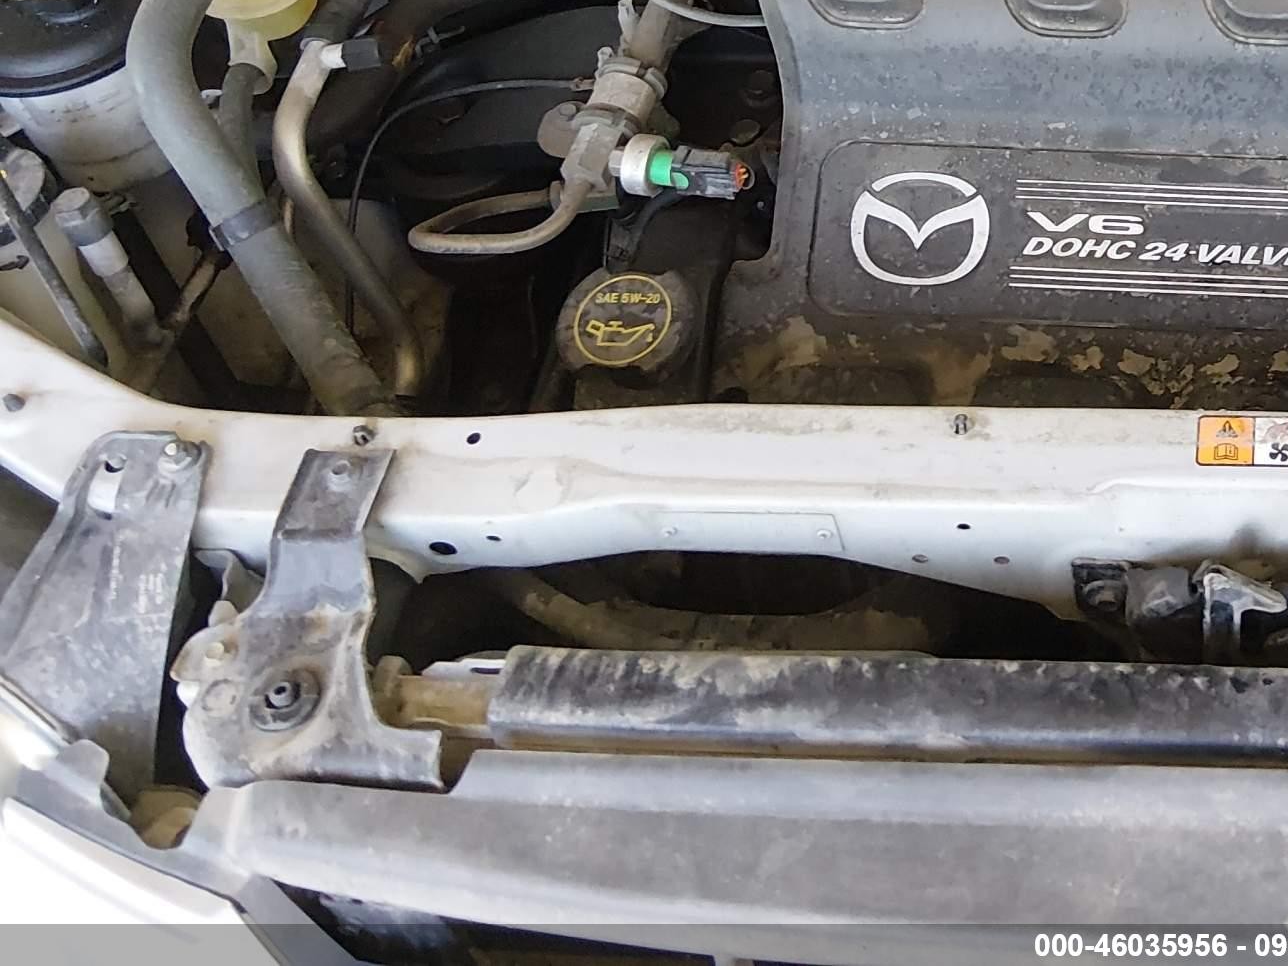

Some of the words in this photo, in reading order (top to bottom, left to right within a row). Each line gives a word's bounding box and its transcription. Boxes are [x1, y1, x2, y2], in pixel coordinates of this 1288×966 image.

[1026, 211, 1145, 235] V6
[1022, 236, 1137, 260] DOHC
[595, 292, 620, 304] SAE
[620, 292, 661, 304] 5W-20
